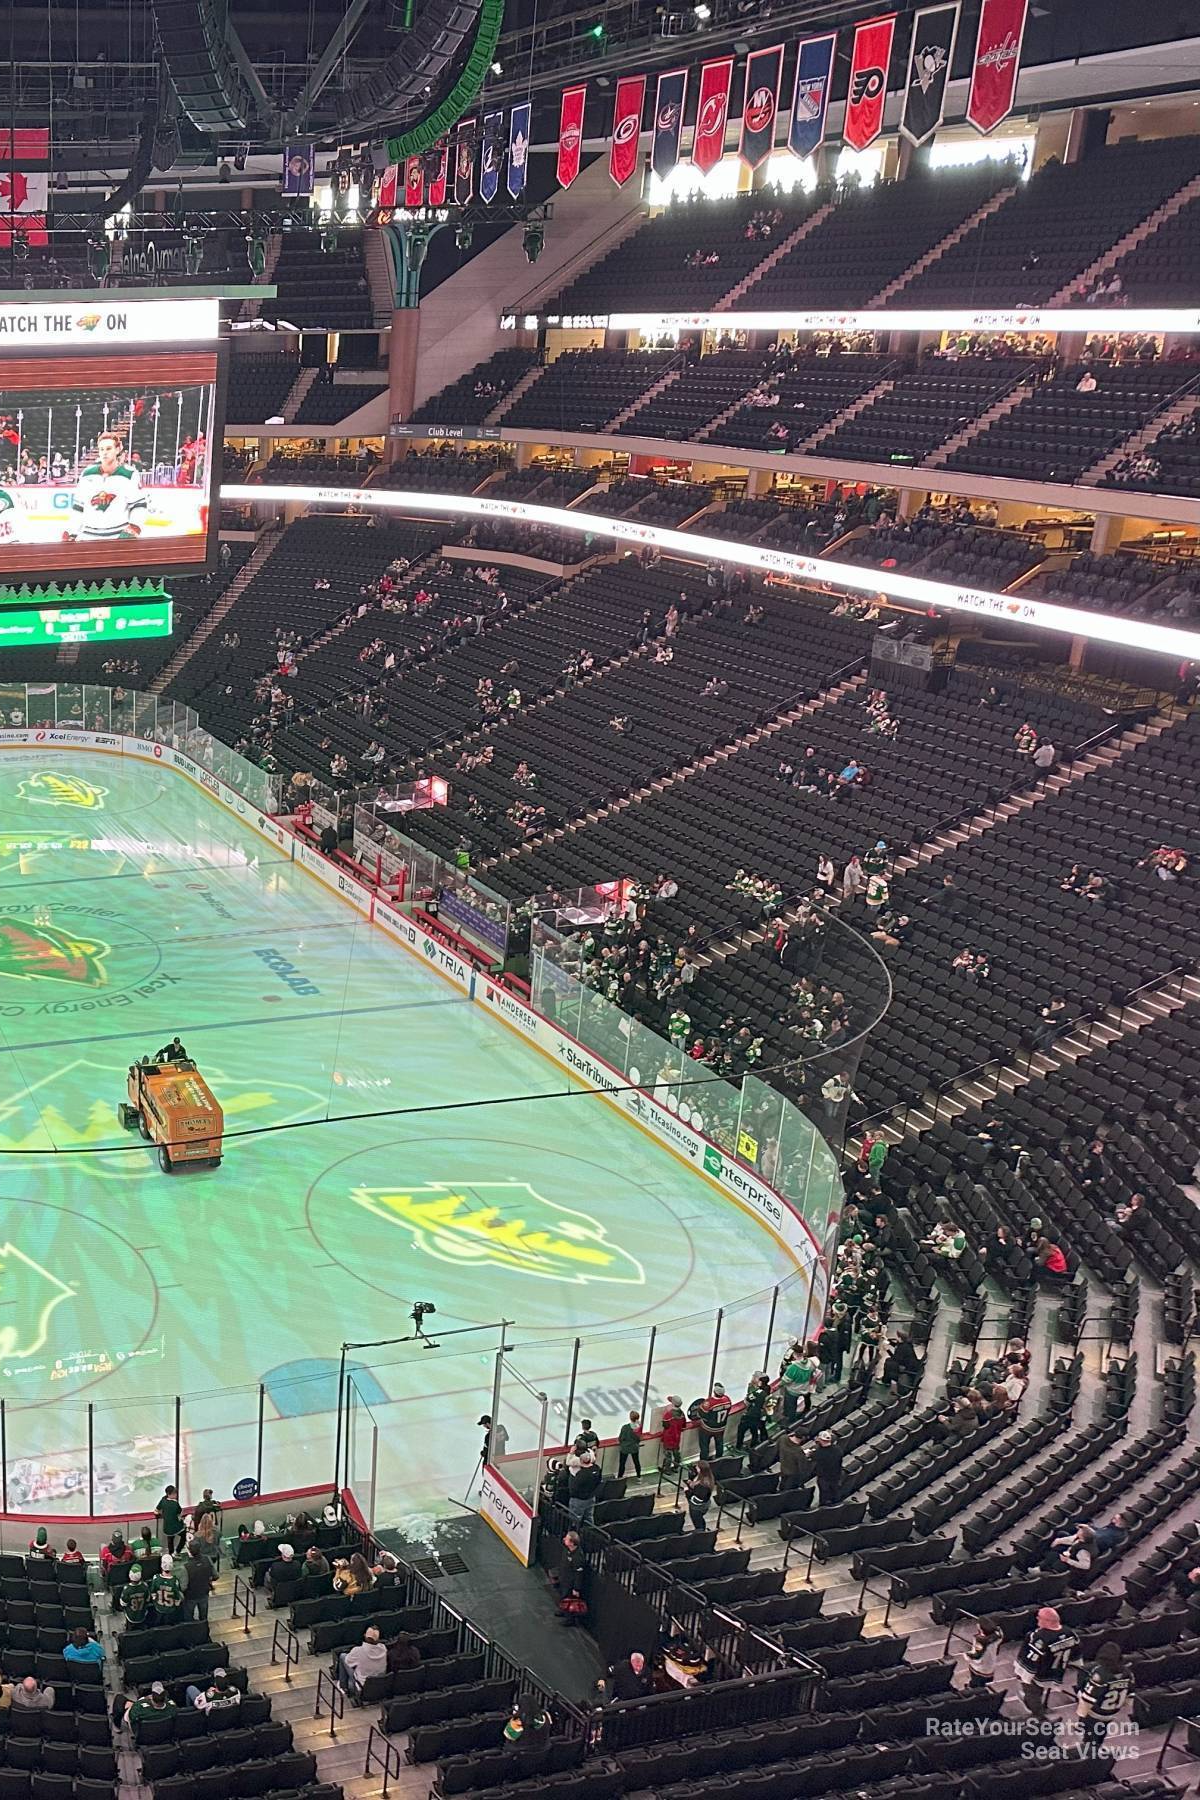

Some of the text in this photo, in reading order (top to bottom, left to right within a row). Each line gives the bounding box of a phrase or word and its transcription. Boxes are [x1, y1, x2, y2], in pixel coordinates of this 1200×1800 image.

[44, 314, 72, 331] THE
[106, 313, 127, 330] ON
[428, 427, 463, 437] Club Level
[760, 553, 781, 566] WATCH
[782, 557, 795, 569] THE
[957, 594, 1036, 618] WATCH THE ON
[95, 736, 120, 746] ESPN+
[136, 743, 153, 753] BMO
[174, 754, 196, 775] BUD LIGHT
[47, 901, 129, 919] Center
[252, 948, 321, 997] ECOLAB
[438, 950, 465, 981] TRIA
[136, 972, 183, 1000] Xcel
[35, 993, 133, 1017] Energy
[501, 999, 537, 1028] ANDERSEN
[566, 1048, 619, 1098] StarTribune
[650, 1107, 699, 1152] TIcasino.com
[706, 1156, 781, 1220] enterprise
[716, 1409, 728, 1424] 17
[481, 1478, 522, 1532] Energy
[1100, 1688, 1129, 1711] 21
